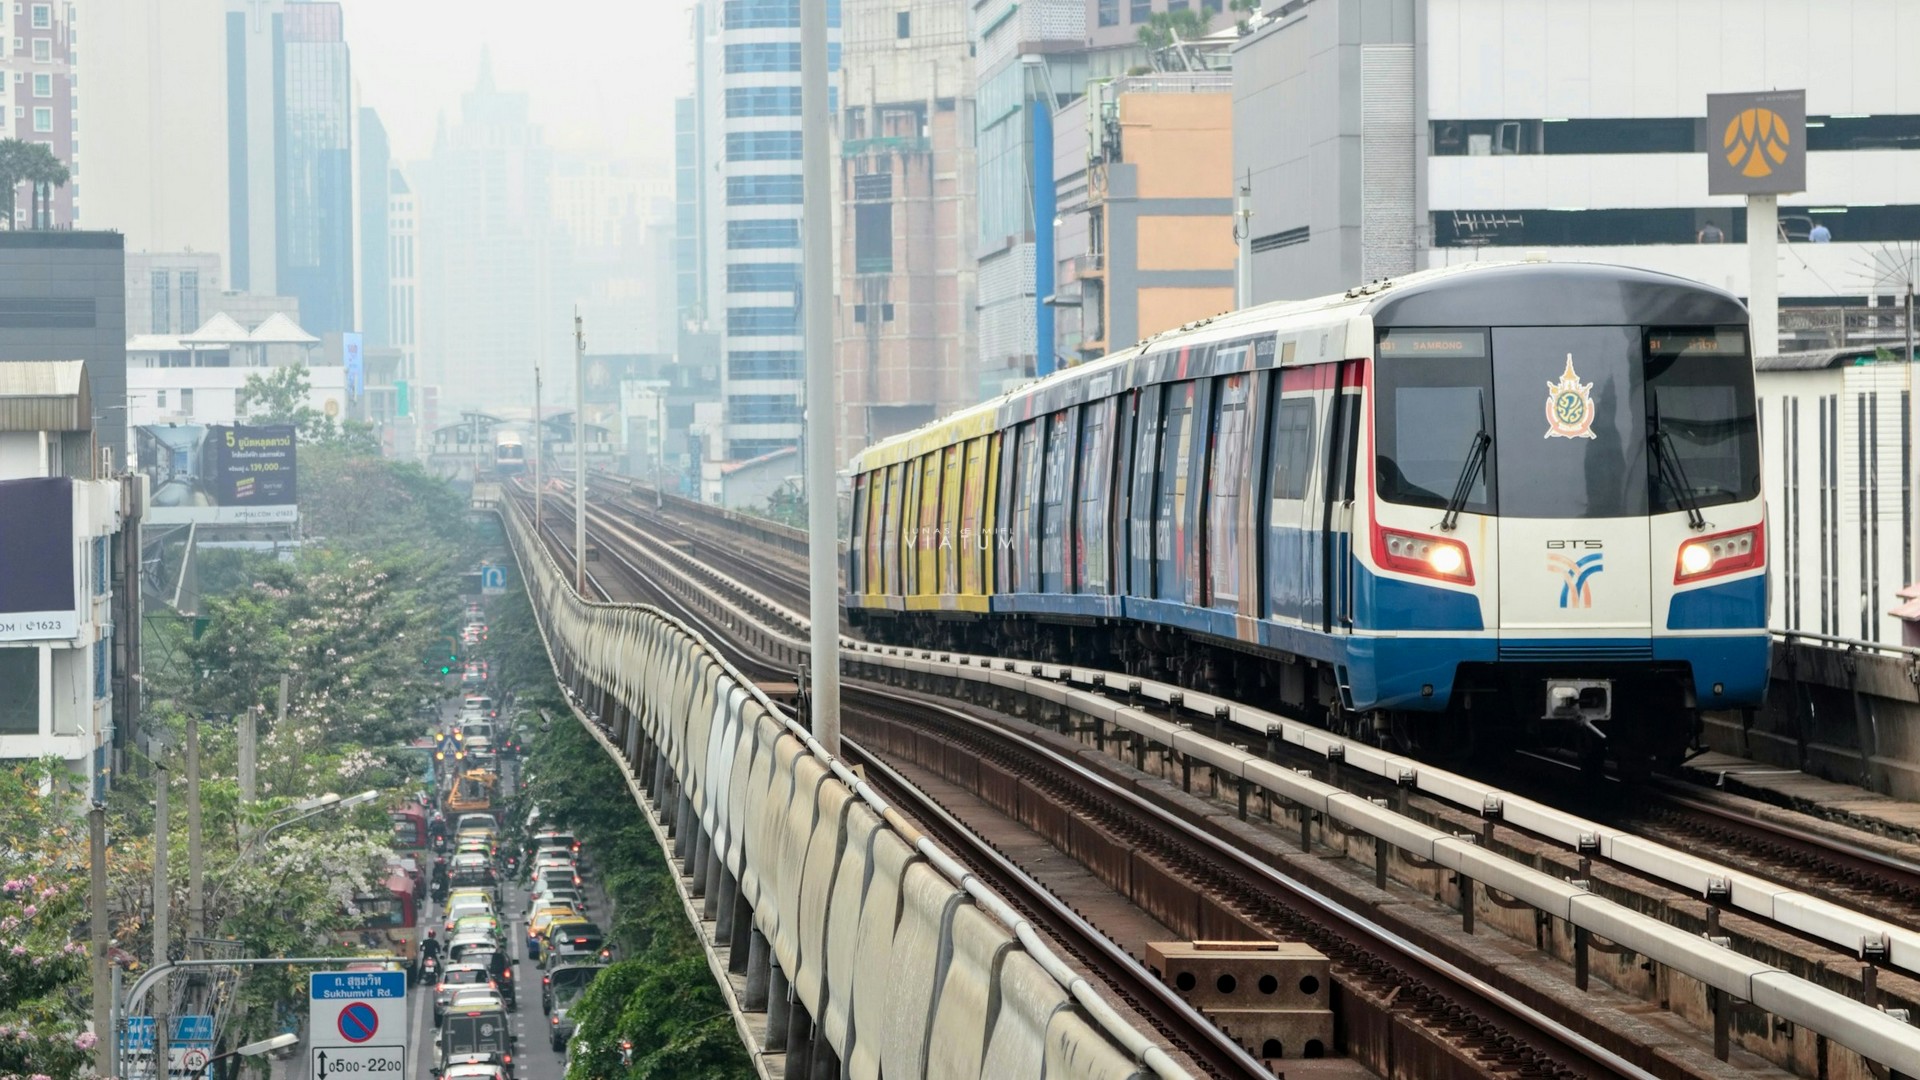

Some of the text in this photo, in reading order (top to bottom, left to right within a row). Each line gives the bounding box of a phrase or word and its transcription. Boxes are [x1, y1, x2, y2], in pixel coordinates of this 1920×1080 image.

[1413, 341, 1463, 351] SAMRONG
[225, 431, 235, 448] 5
[250, 463, 279, 473] 139,000
[1547, 540, 1603, 549] BTS
[36, 621, 61, 630] 1623
[347, 974, 381, 989] สุขุมวิท
[323, 988, 393, 998] Sukhumvit Rd.
[188, 1056, 202, 1067] 45
